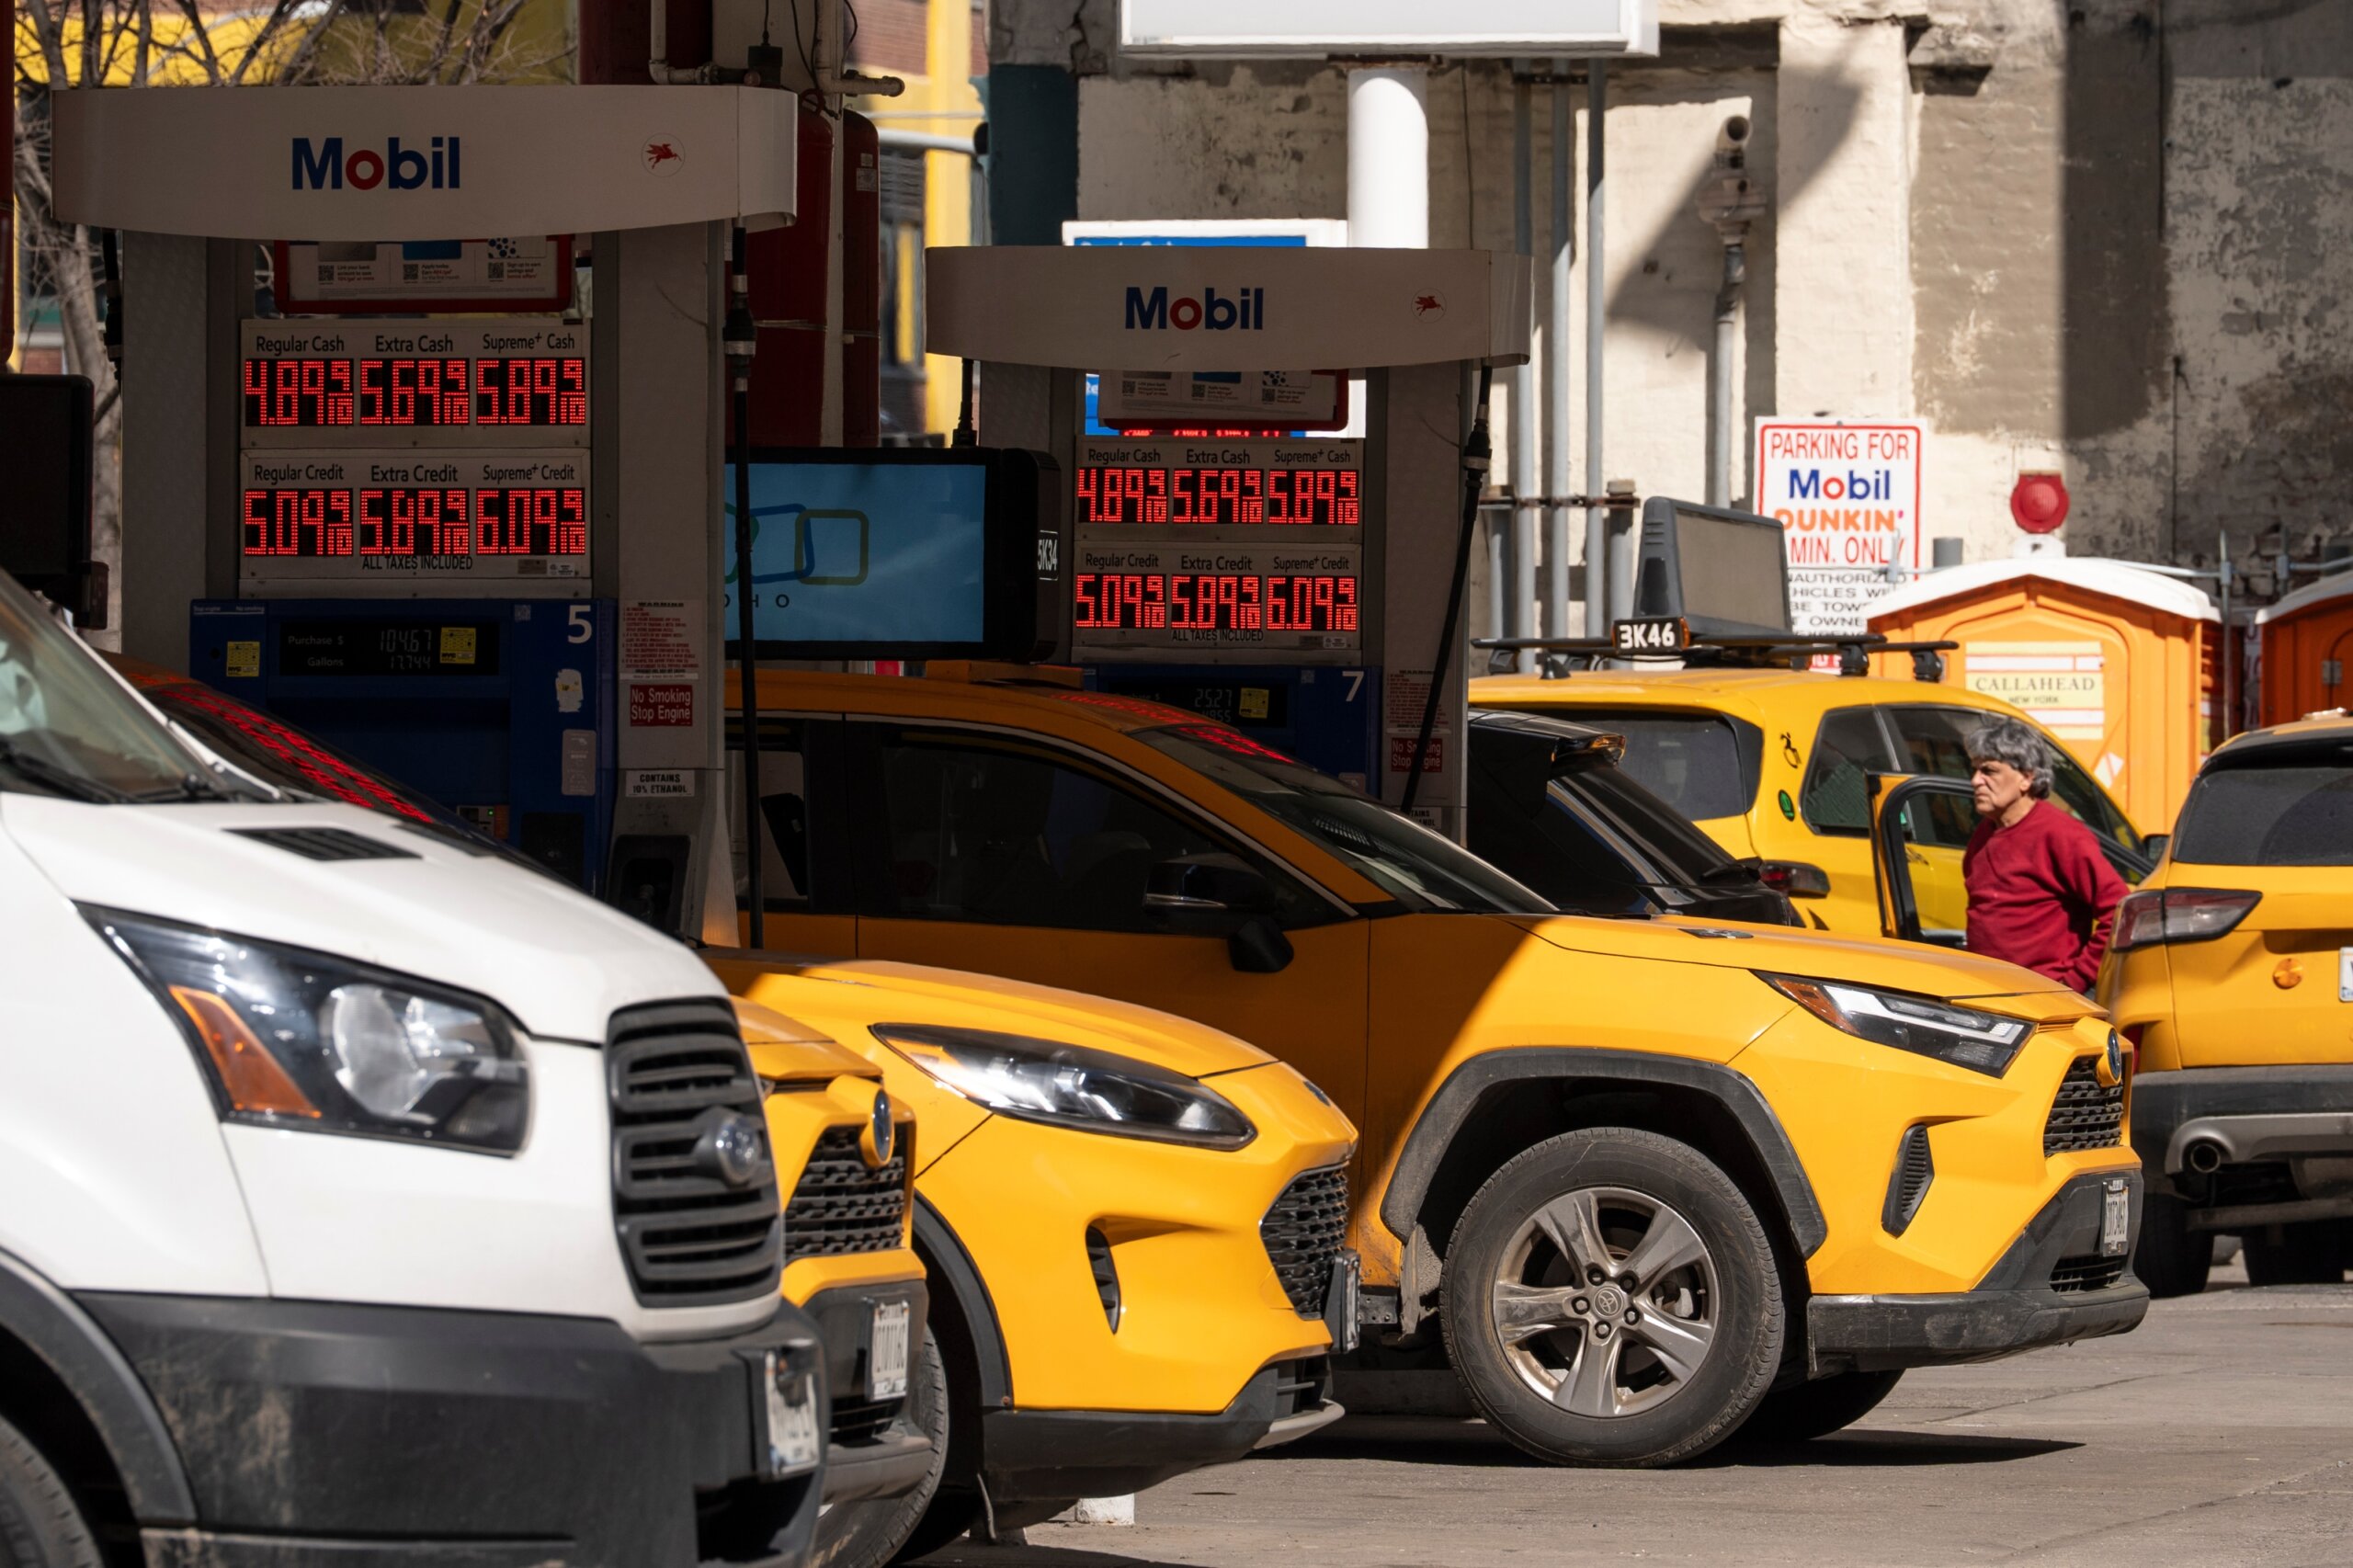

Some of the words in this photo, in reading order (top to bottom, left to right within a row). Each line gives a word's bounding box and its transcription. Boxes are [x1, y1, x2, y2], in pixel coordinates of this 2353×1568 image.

[292, 136, 460, 190] Mobil
[1125, 287, 1264, 330] Mobil
[256, 336, 308, 356] Regular
[312, 335, 345, 351] Cash
[376, 336, 413, 352] Extra
[418, 335, 453, 352] Cash
[547, 334, 574, 349] Cash
[1771, 433, 1859, 460] PARKING
[1868, 433, 1909, 460] FOR
[1088, 449, 1131, 465] Regular
[1133, 449, 1161, 462] Cash
[1187, 449, 1217, 464] Extra
[1221, 449, 1250, 464] Cash
[1327, 449, 1351, 462] Cash
[255, 465, 301, 482] Regular
[305, 465, 344, 480] Credit
[371, 466, 408, 482] Extra
[413, 465, 458, 483] Credit
[541, 465, 574, 481] Credit
[1789, 469, 1890, 500] Mobil
[1037, 539, 1058, 571] 5K34
[1791, 537, 1836, 564] MIN.
[362, 555, 382, 570] ALL
[386, 555, 418, 570] TAXES
[420, 555, 472, 570] INCLUDED
[1086, 553, 1125, 568] Regular
[1128, 553, 1159, 568] Credit
[1181, 555, 1212, 570] Extra
[1216, 555, 1253, 571] Credit
[1322, 557, 1349, 570] Credit
[567, 605, 593, 644] 5
[1809, 616, 1865, 627] OWNE
[288, 635, 333, 646] Purchase
[337, 634, 345, 646] $
[1172, 630, 1188, 641] ALL
[1190, 630, 1218, 641] TAXES
[1220, 631, 1264, 642] INCLUDED
[1619, 622, 1676, 649] 3K46
[307, 656, 345, 667] Gallons
[1342, 671, 1365, 702] 7
[1975, 676, 2096, 691] CALLAHEAD
[631, 687, 644, 703] No
[648, 687, 691, 706] Smoking
[2008, 696, 2029, 704] NEW
[2034, 696, 2059, 704] YORK
[631, 704, 654, 722] Stop
[658, 705, 691, 723] Engine
[1392, 739, 1404, 753] No
[1406, 740, 1441, 756] Sming
[1392, 754, 1412, 769] Stop
[640, 774, 680, 783] CONTAINS
[651, 785, 688, 794] ETHANOL
